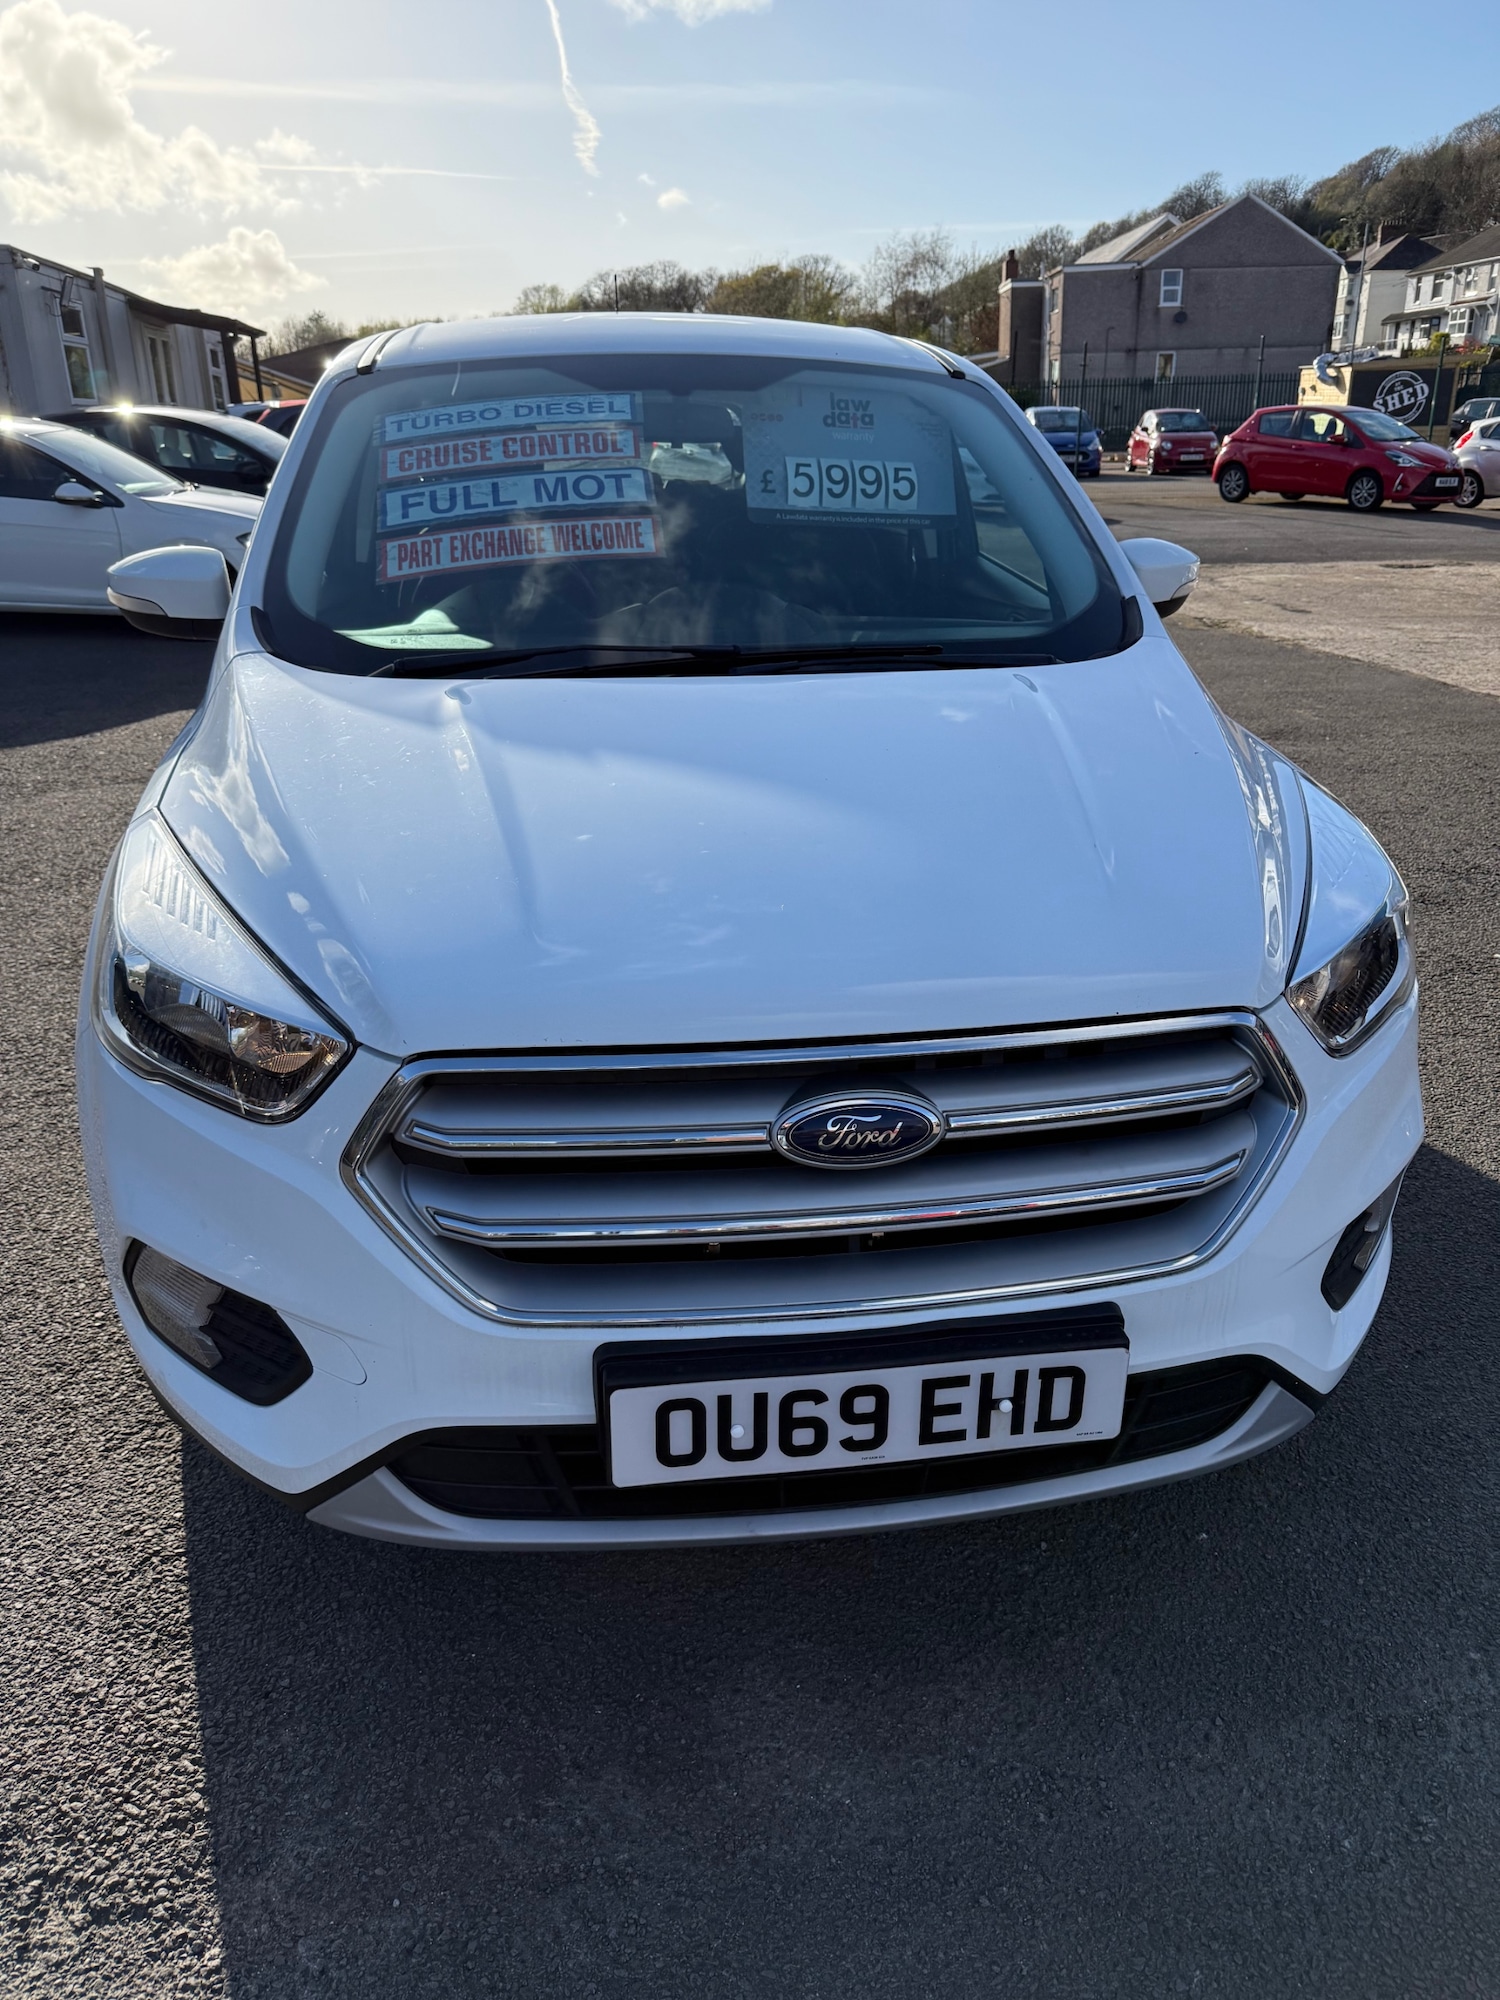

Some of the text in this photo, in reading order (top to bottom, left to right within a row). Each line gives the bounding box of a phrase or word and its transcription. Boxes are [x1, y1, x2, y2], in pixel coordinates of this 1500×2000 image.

[830, 392, 872, 412] law
[1373, 383, 1430, 413] SHED
[390, 400, 626, 433] TURBO DIESEL
[822, 411, 874, 429] data
[398, 431, 625, 473] CRUISE CONTROL
[832, 431, 875, 444] warranty
[401, 474, 633, 520] FULL MOT
[792, 462, 917, 501] 5995
[397, 521, 645, 571] PART EXCHANGE WELCOME
[818, 1114, 904, 1149] Ford
[655, 1365, 1087, 1467] OU69 EHD
